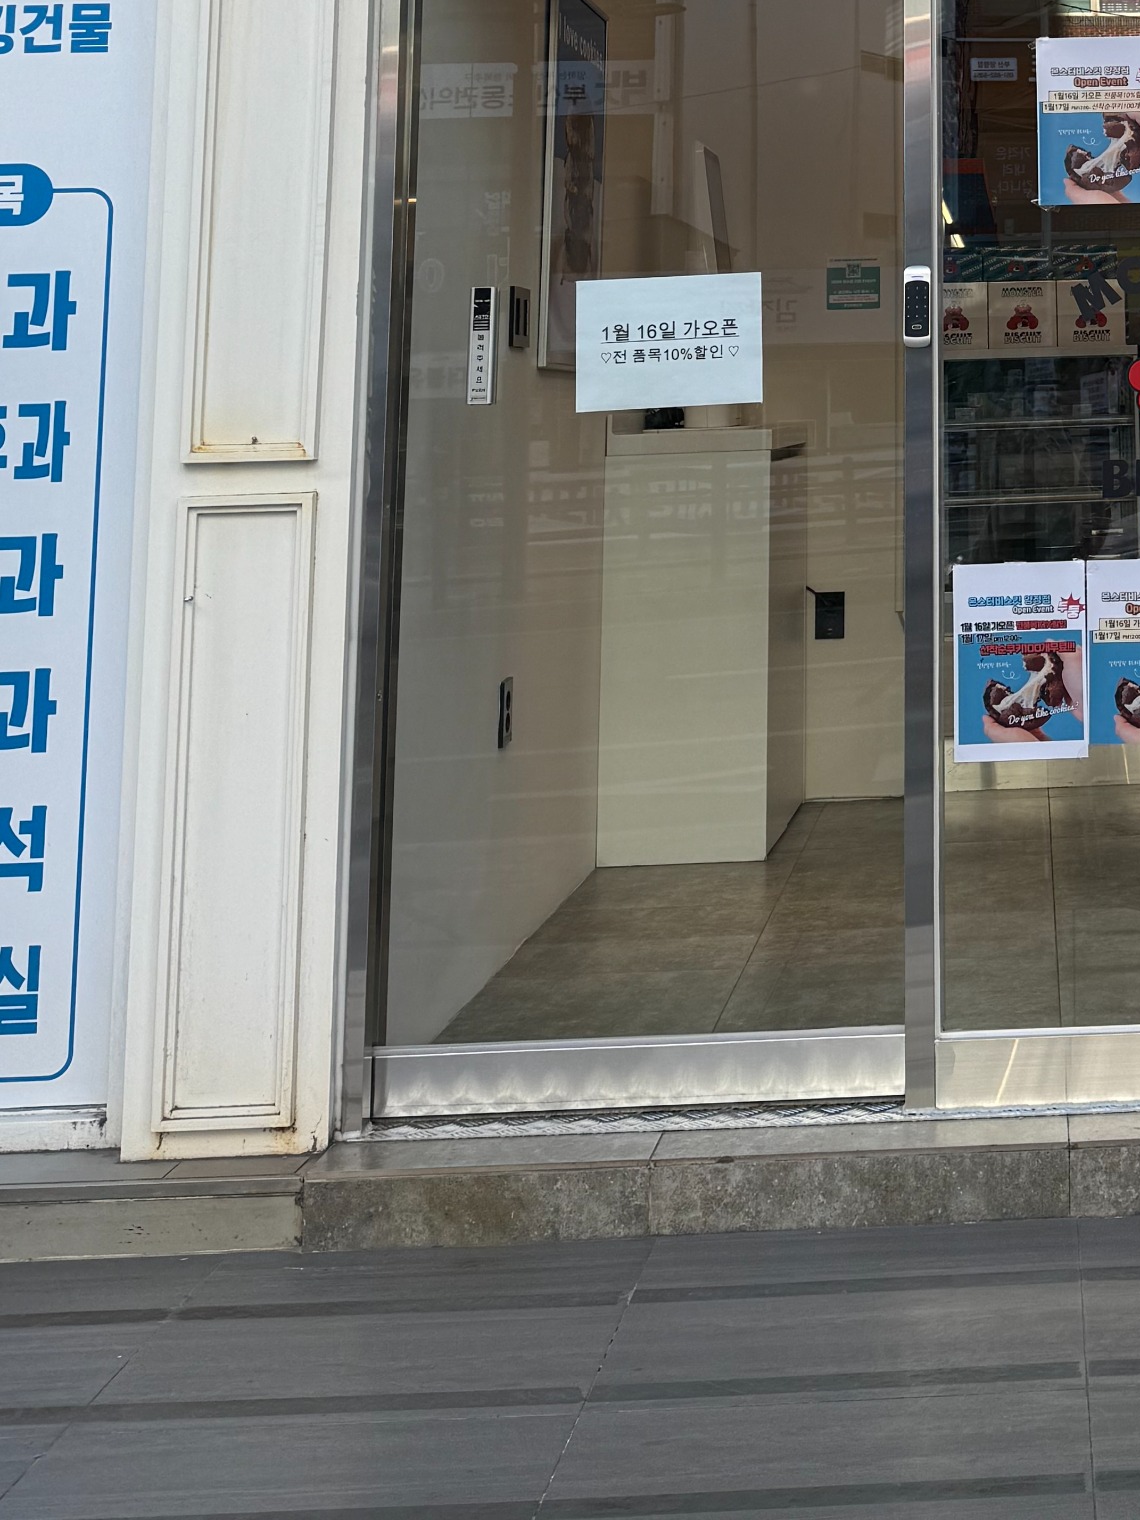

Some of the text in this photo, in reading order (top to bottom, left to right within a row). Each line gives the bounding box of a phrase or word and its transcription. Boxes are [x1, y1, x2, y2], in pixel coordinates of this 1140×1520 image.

[1074, 77, 1128, 88] Open Event
[1089, 173, 1101, 183] Do
[1101, 171, 1115, 184] you
[1001, 286, 1044, 298] MONSTER
[3, 271, 77, 351] 과
[601, 318, 739, 342] 1월 16일 가오픈
[1073, 329, 1111, 342] BISCUIT
[1004, 331, 1042, 344] BISCUIT
[632, 344, 724, 364] 품목10%할인
[0, 532, 64, 618] 과
[1012, 605, 1054, 615] Open Event
[1008, 714, 1019, 725] Do
[1020, 712, 1034, 726] you
